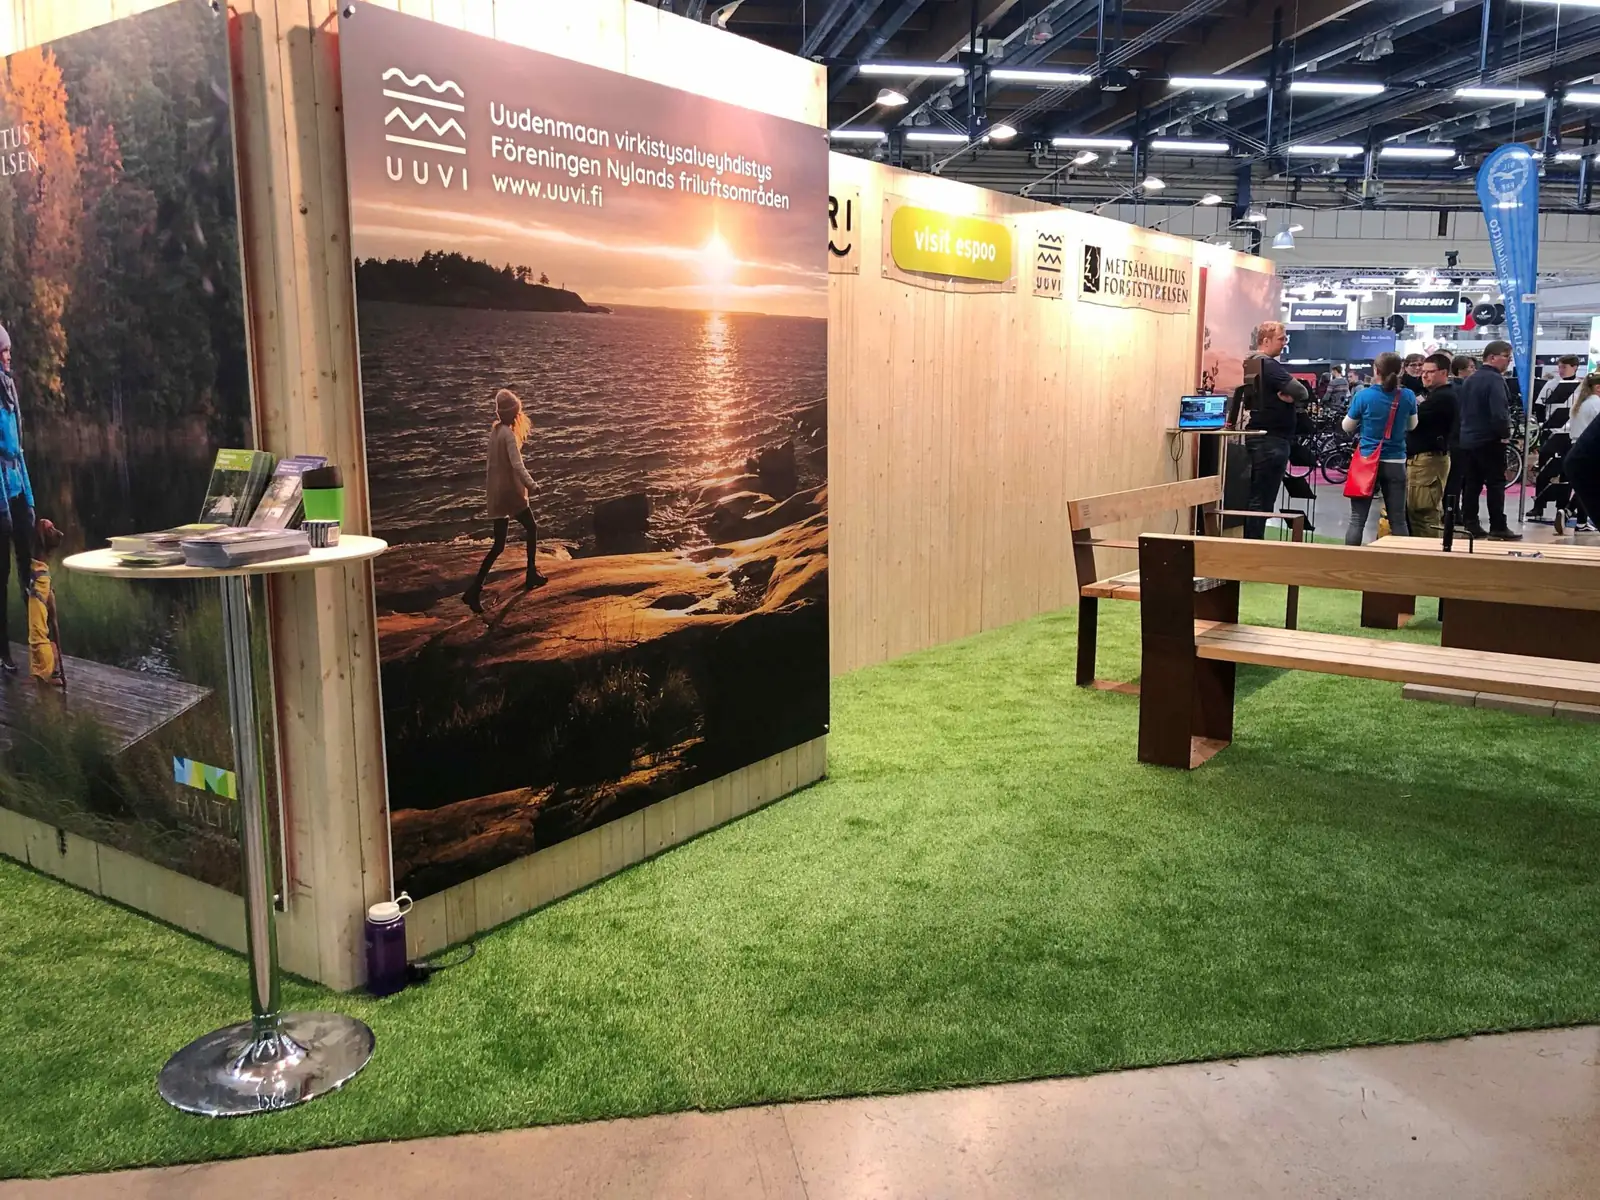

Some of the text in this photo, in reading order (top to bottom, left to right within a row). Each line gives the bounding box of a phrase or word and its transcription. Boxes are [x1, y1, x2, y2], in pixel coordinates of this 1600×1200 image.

[490, 101, 773, 184] Uudenmaan virkistysalueyhdistys
[386, 156, 468, 191] UUVI
[491, 135, 790, 210] Föreningen Nylands friluftsområden
[491, 174, 603, 208] www.uuvi.fi
[914, 226, 996, 263] visit espoo
[1036, 276, 1061, 291] UUVI
[1105, 257, 1186, 286] METSÄHALLITUS
[1400, 298, 1454, 306] NISHIKI
